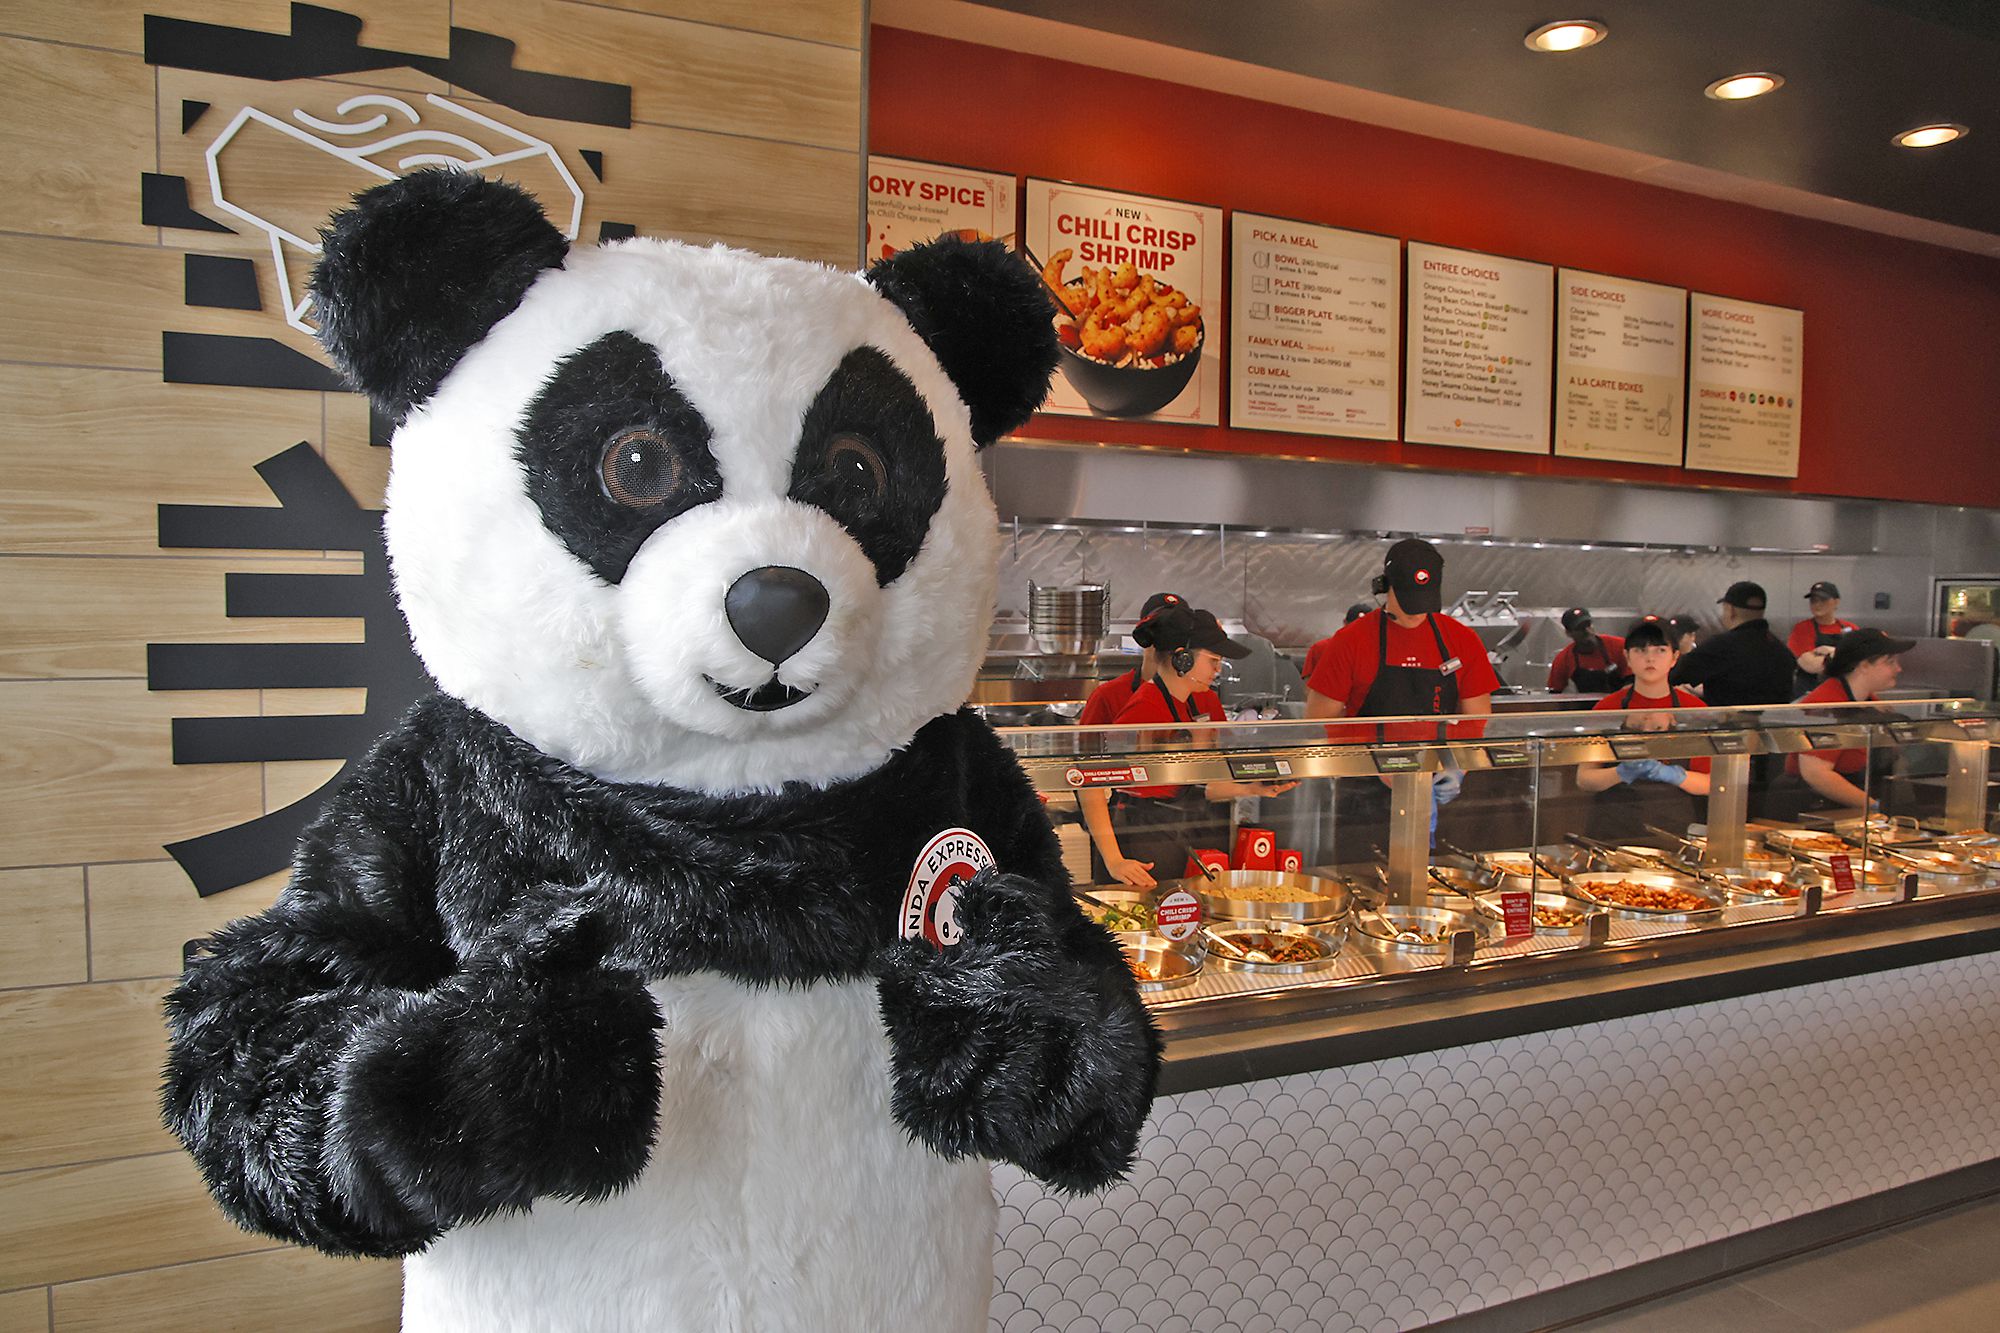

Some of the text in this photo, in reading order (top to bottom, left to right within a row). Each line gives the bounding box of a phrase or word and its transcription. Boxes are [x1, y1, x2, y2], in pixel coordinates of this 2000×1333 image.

[869, 175, 915, 197] ORY
[920, 183, 985, 207] SPICE
[877, 209, 896, 218] Chili
[897, 212, 918, 223] Crisp
[1115, 208, 1141, 221] NEW
[1057, 214, 1197, 251] CHILI CRISP
[1253, 230, 1318, 249] PICK A MEAL
[1079, 242, 1175, 272] SHRIMP
[1274, 254, 1300, 266] BOWL
[1423, 260, 1459, 275] ENTREE
[1461, 266, 1500, 281] CHOICES
[1274, 279, 1300, 290] PLATE
[1423, 282, 1446, 292] Orange
[1448, 286, 1471, 295] Chicken
[1570, 286, 1626, 303] SIDE CHOICES
[1424, 292, 1442, 303] String
[1443, 296, 1459, 304] Bean
[1460, 298, 1483, 307] Chicken
[1485, 302, 1503, 311] Breast
[1274, 305, 1305, 317] BIGGER
[1308, 310, 1333, 321] PLATE
[1424, 304, 1440, 314] Kung
[1441, 306, 1453, 314] Pao
[1454, 308, 1477, 317] Chicken
[1702, 309, 1755, 324] MORE CHOICES
[1423, 315, 1455, 324] Mushroom
[1457, 318, 1480, 327] Chicken
[1423, 325, 1444, 336] Beijing
[1446, 328, 1459, 336] Beef
[1570, 325, 1585, 333] Super
[1248, 336, 1279, 347] FAMILY
[1281, 340, 1304, 350] MEAL
[1423, 335, 1447, 345] Broccoli
[1449, 339, 1462, 347] Beef
[1570, 343, 1583, 351] Fried
[1423, 346, 1439, 355] Black
[1441, 348, 1462, 358] Pepper
[1463, 352, 1482, 361] Angus
[1484, 354, 1499, 362] Steak
[1423, 358, 1442, 367] Honey
[1444, 361, 1464, 369] Walnut
[1465, 363, 1486, 372] Shrimp
[1248, 366, 1291, 378] CUB MEAL
[1422, 368, 1442, 377] Grilled
[1443, 370, 1465, 379] Teriyaki
[1466, 373, 1489, 381] Chicken
[1422, 380, 1439, 388] Honey
[1441, 380, 1461, 390] Sesame
[1462, 383, 1483, 392] Chicken
[1569, 376, 1644, 393] A LA CARTE BOXES
[1452, 393, 1475, 402] Chicken
[1700, 389, 1727, 400] DRINKS
[909, 840, 990, 937] NDA EXPRESS
